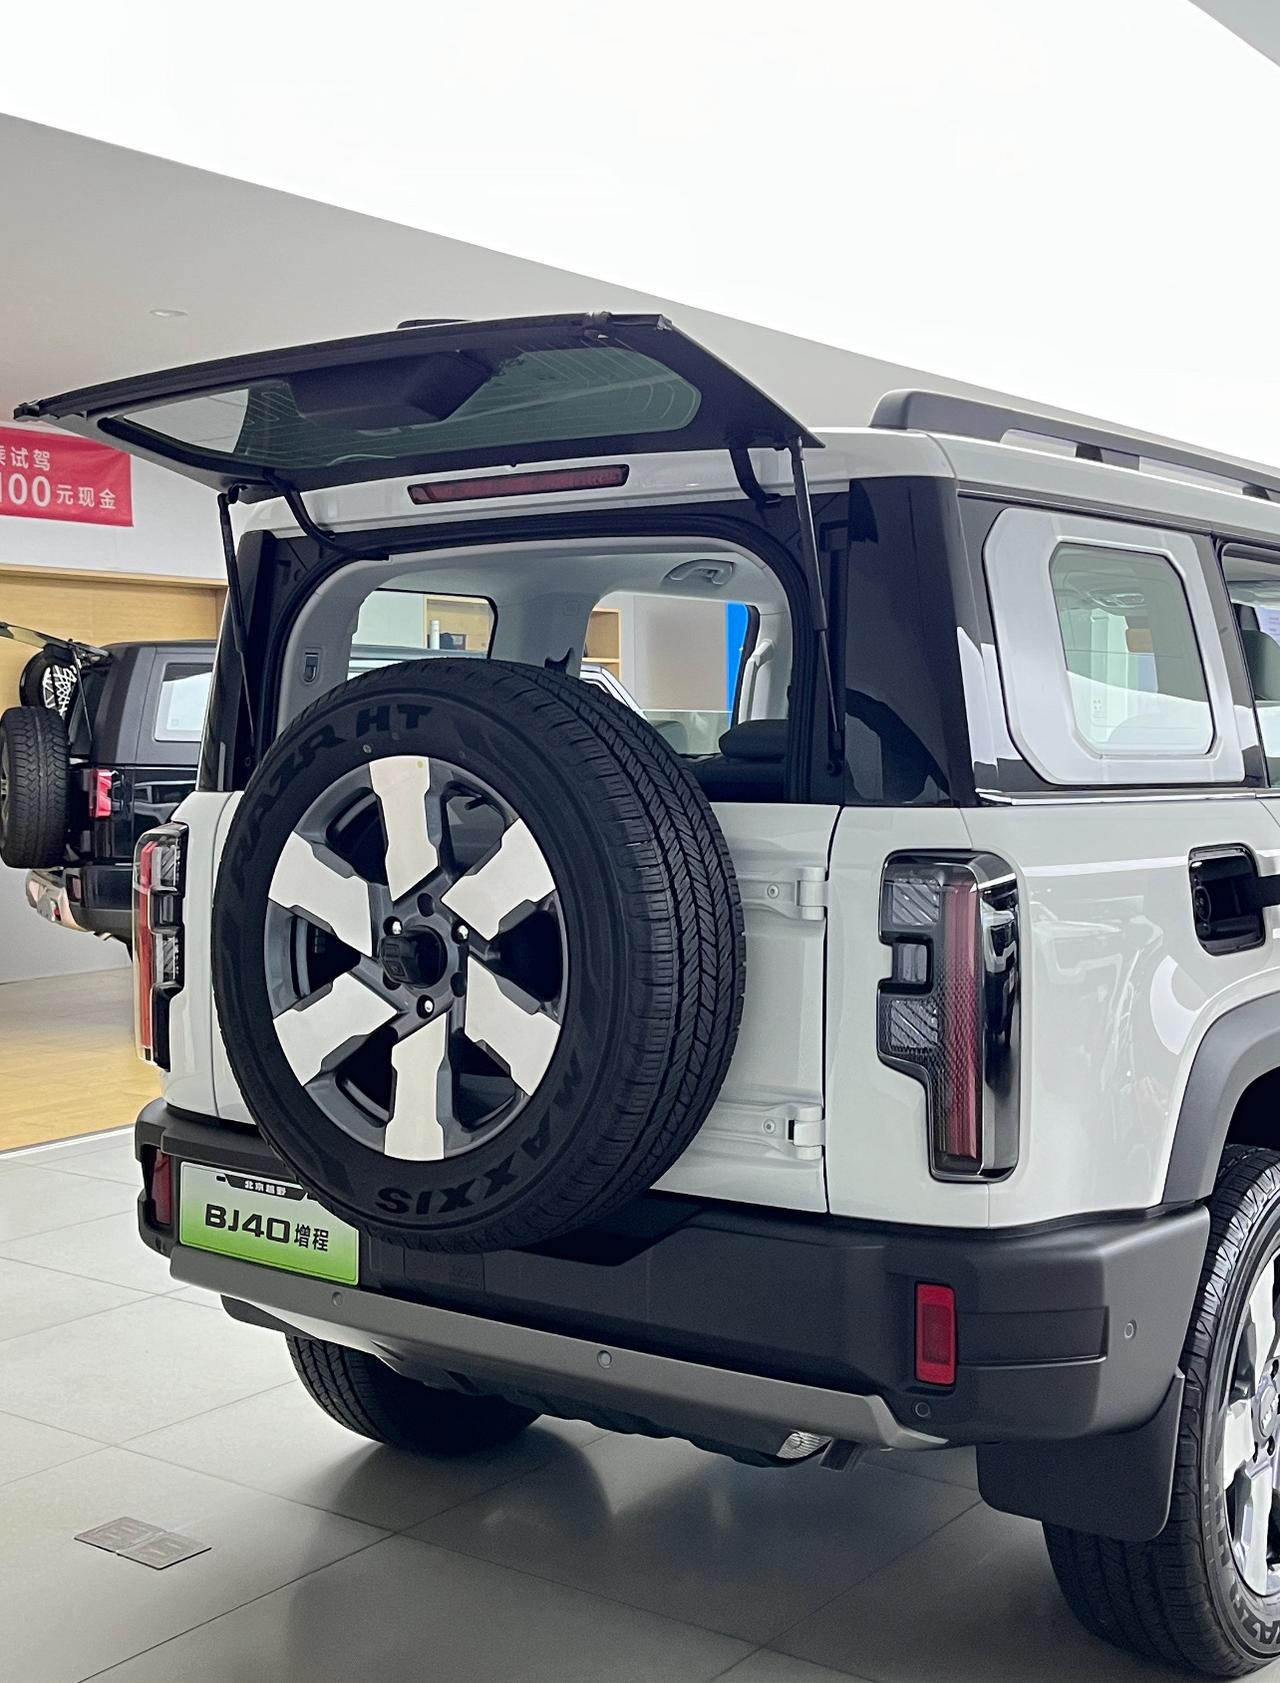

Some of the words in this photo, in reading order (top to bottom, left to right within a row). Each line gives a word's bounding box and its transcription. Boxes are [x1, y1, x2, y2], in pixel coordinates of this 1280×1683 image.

[355, 703, 433, 738] HT
[375, 1047, 583, 1215] MAXXIS
[244, 1179, 287, 1196] 北京越野
